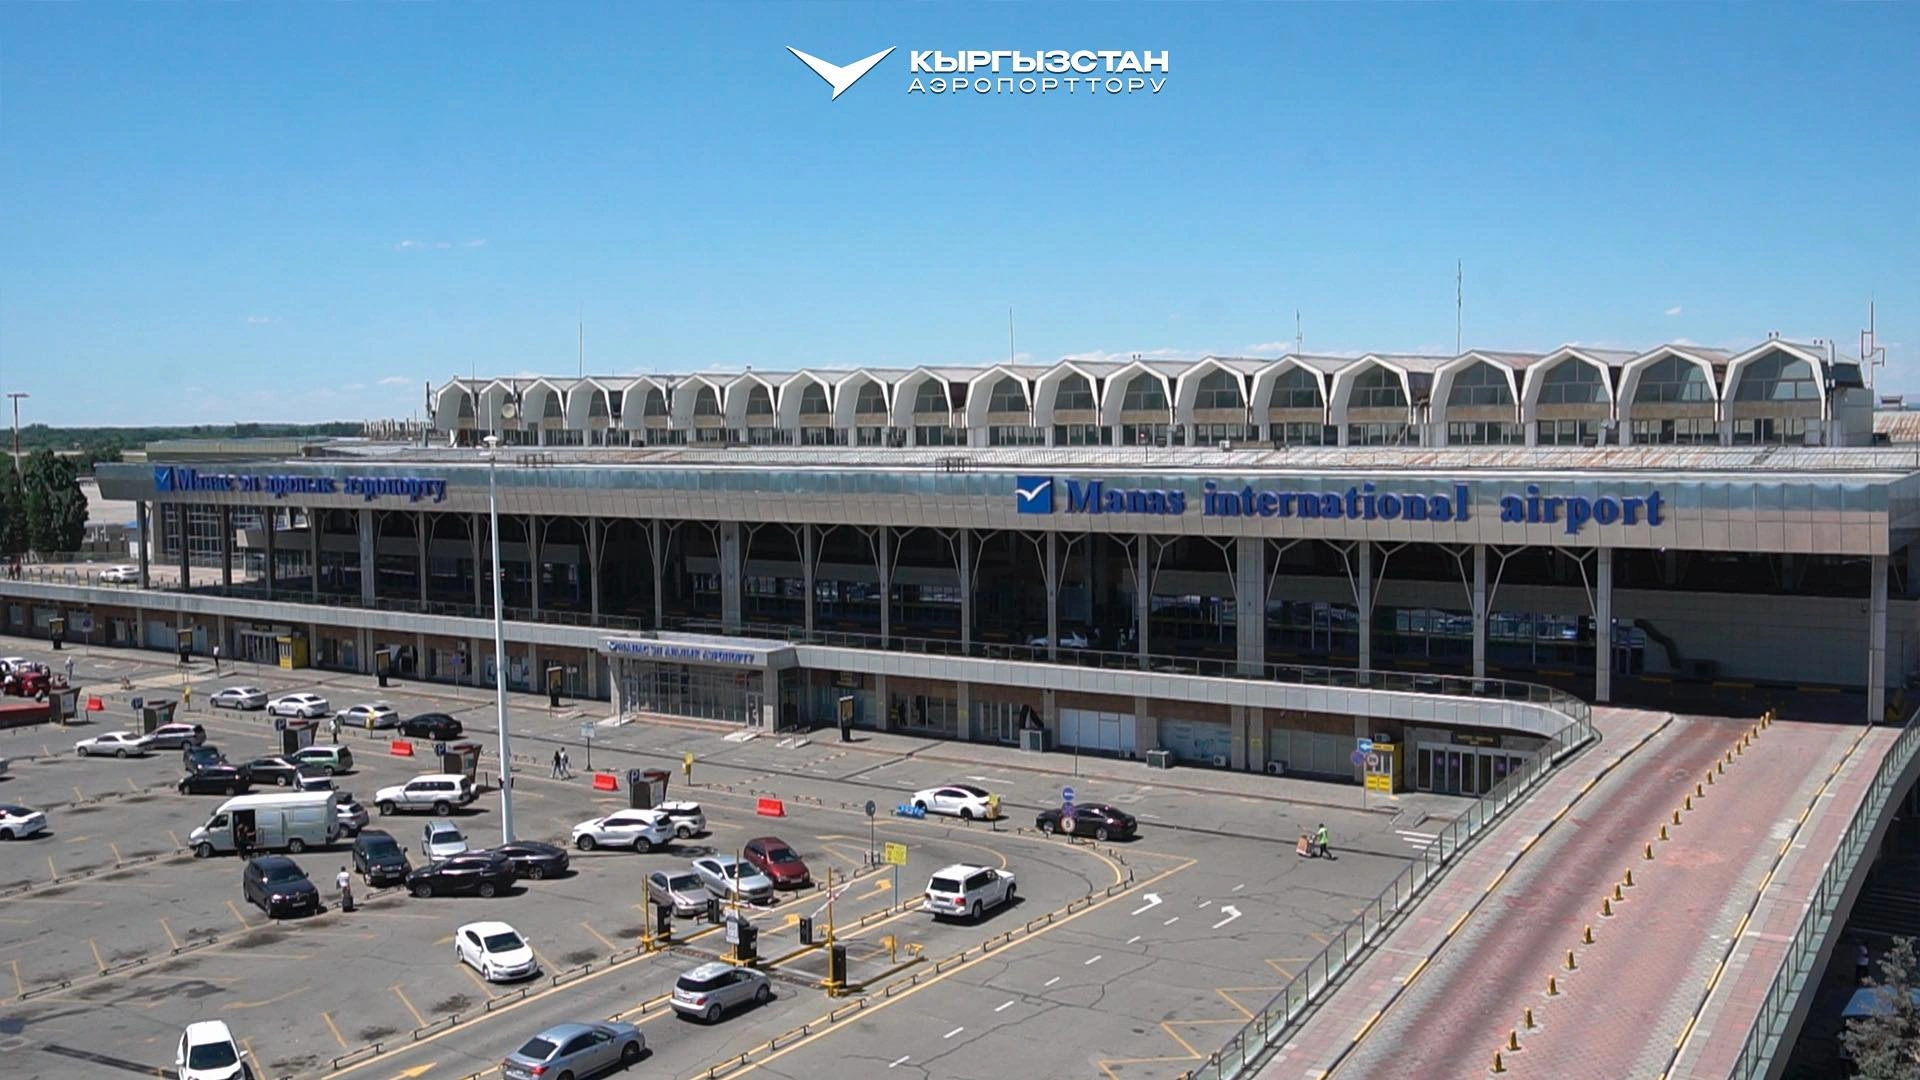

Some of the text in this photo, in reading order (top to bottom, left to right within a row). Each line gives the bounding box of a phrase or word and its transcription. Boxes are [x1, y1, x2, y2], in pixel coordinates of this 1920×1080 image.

[1065, 479, 1665, 535] Manas international airport
